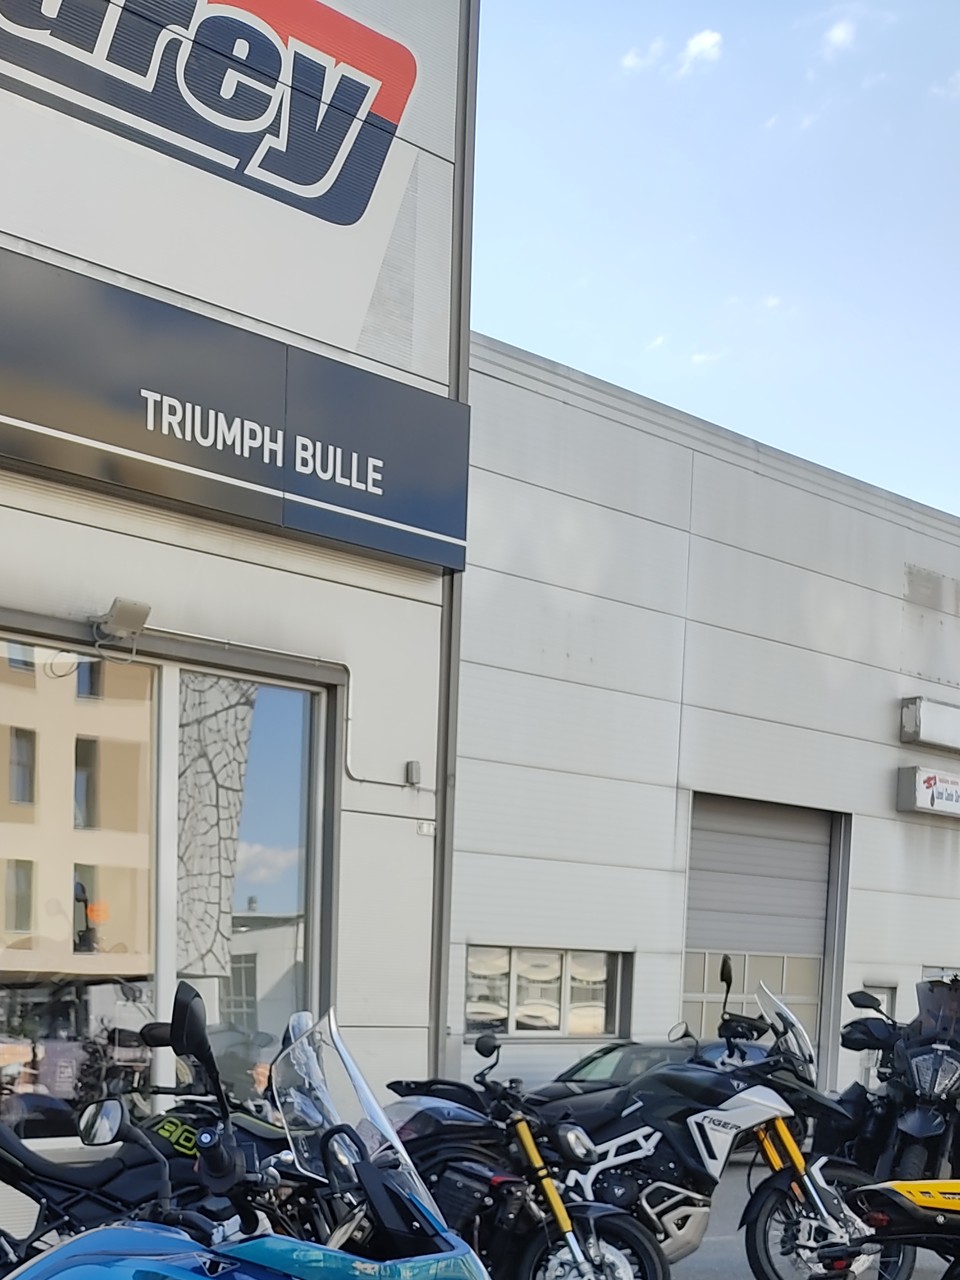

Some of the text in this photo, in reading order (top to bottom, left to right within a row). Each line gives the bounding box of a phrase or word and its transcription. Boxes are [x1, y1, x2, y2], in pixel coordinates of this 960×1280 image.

[140, 388, 385, 496] TRIUMPH BULLE
[701, 1115, 742, 1131] TIGER
